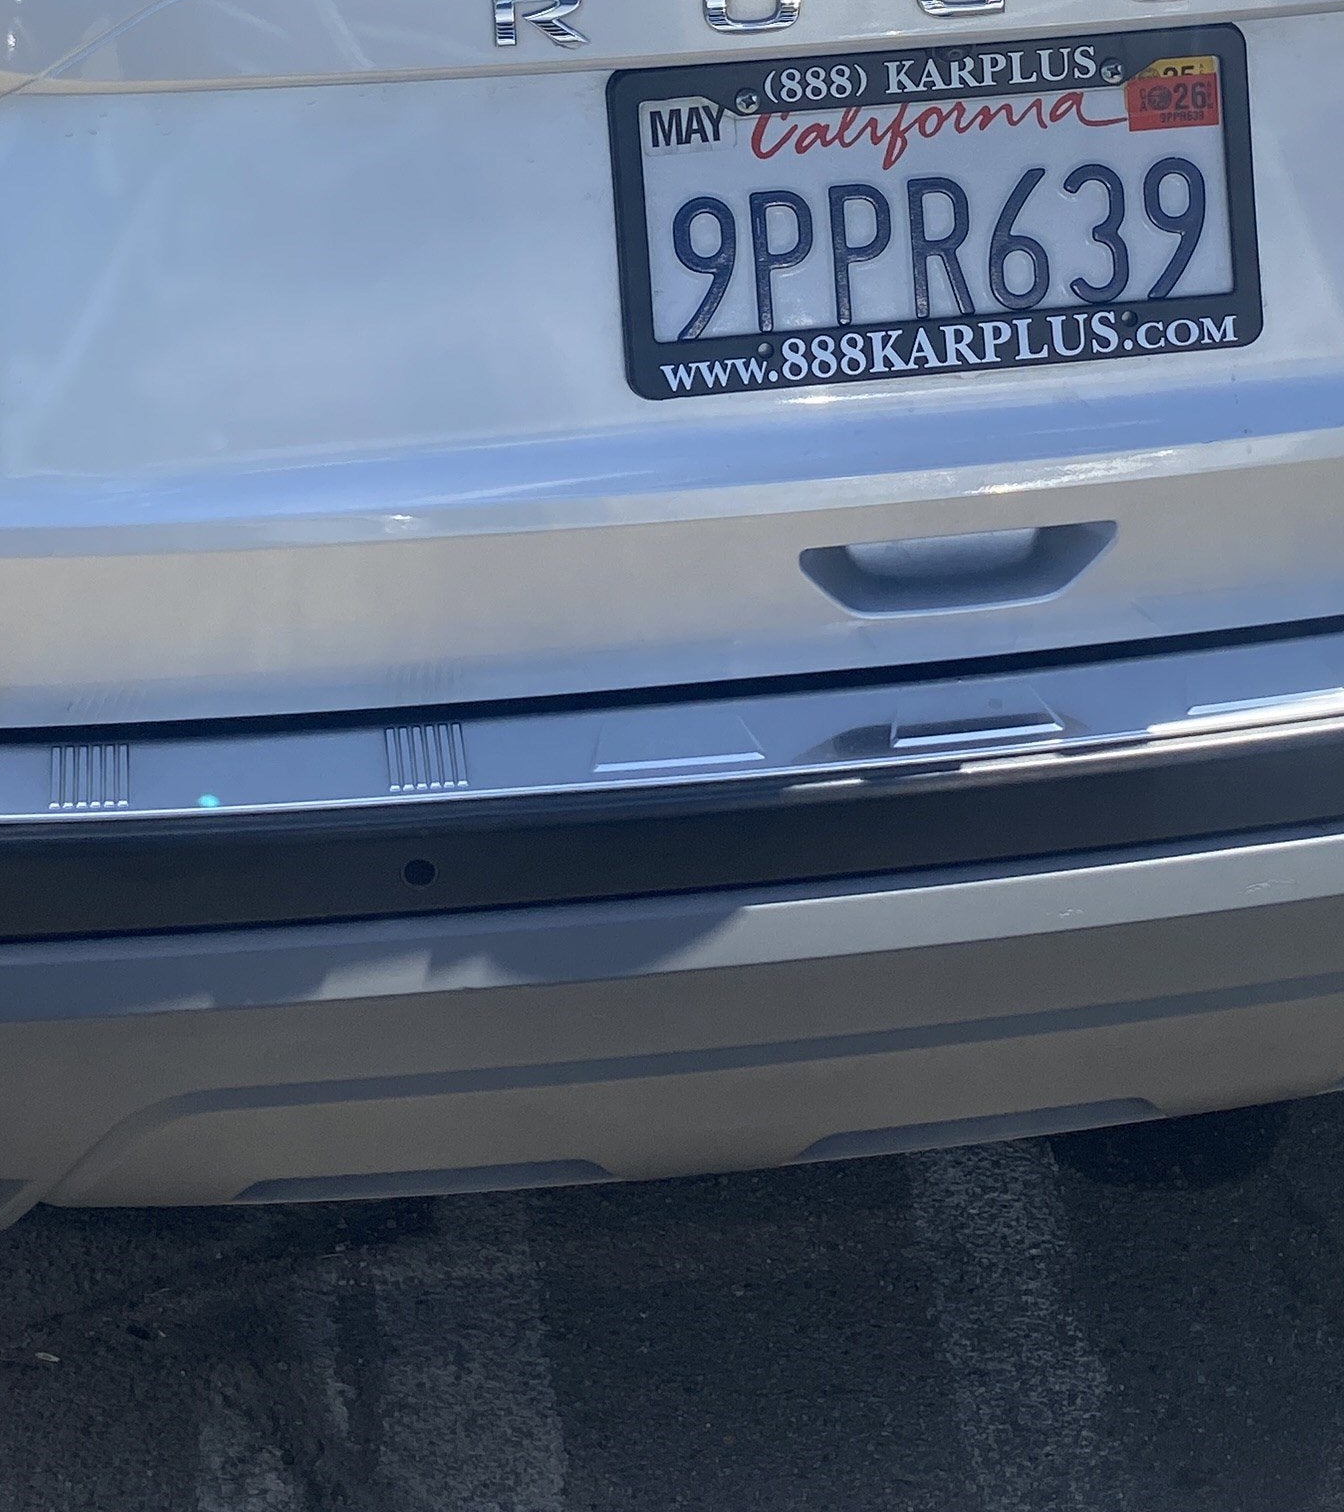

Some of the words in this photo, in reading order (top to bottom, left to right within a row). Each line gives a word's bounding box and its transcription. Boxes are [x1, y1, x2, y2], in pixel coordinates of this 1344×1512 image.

[763, 49, 868, 104] (888)
[884, 46, 1097, 94] KARPLUS
[1173, 82, 1207, 110] 26
[649, 104, 725, 148] MAY
[751, 91, 1128, 171] California
[672, 156, 1205, 341] 9PPR639
